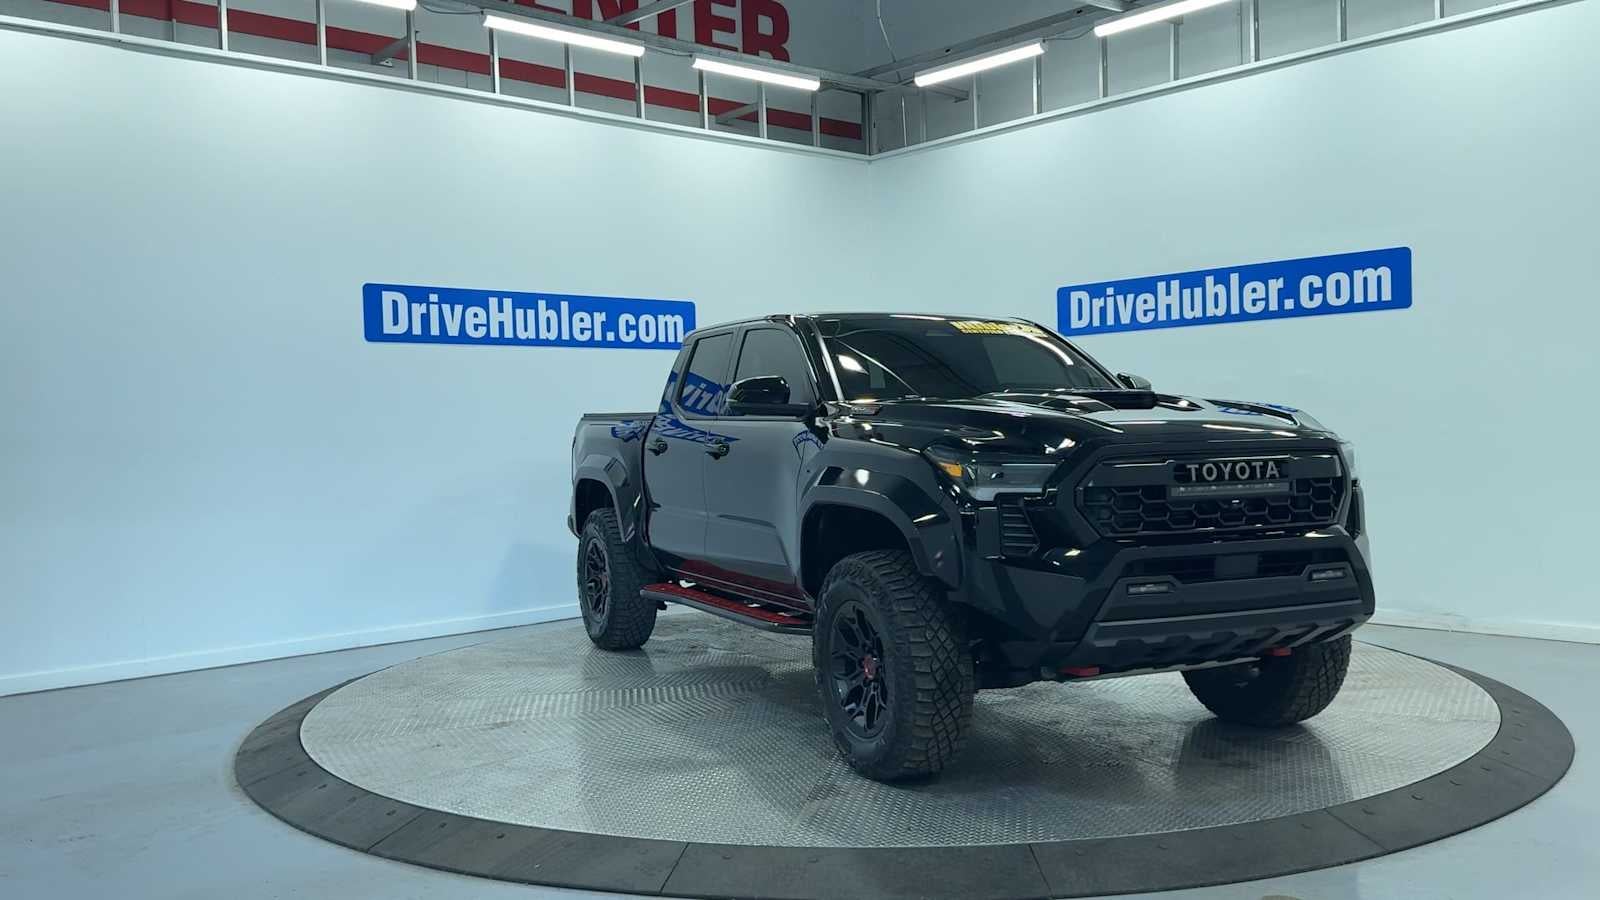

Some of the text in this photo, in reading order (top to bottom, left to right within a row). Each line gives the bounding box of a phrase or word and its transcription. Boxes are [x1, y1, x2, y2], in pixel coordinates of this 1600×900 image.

[381, 290, 684, 343] DriveHubler.com
[1069, 265, 1392, 329] DriveHubler.com
[1186, 461, 1280, 482] TOYOTA
